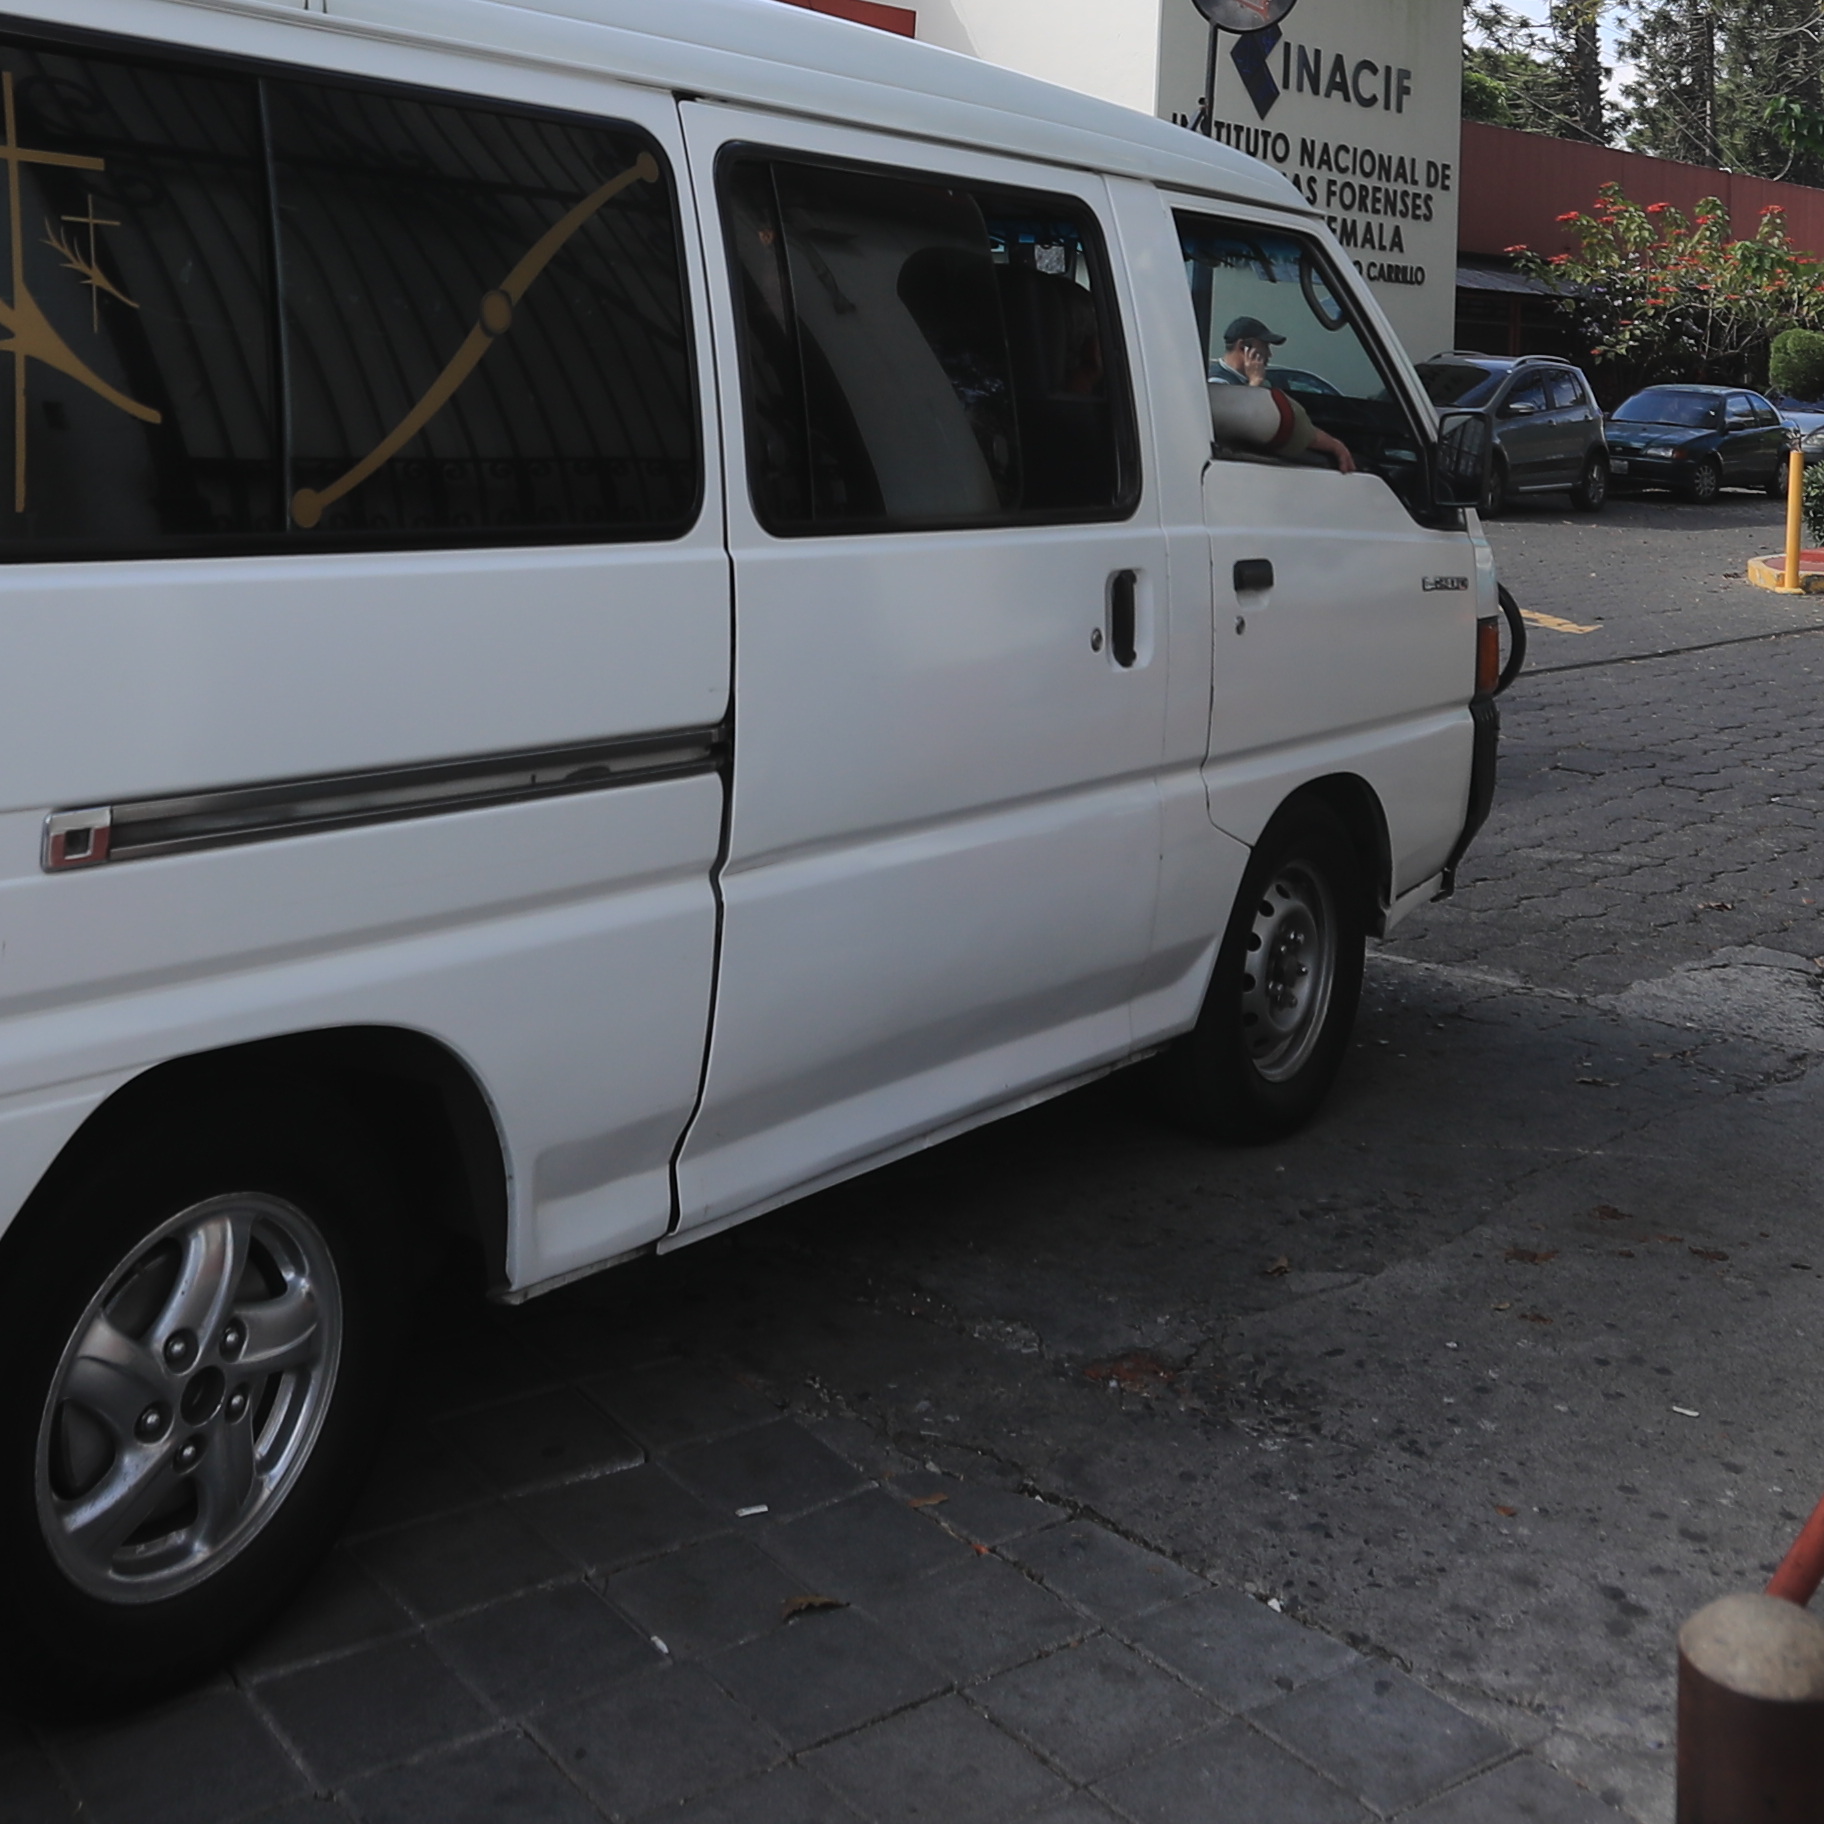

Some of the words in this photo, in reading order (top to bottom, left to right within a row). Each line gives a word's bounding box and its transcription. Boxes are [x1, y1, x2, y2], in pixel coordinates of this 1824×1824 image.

[1282, 41, 1412, 114] INACIF
[1300, 137, 1419, 186] NACIONAL
[1426, 160, 1451, 191] DE
[1326, 179, 1433, 222] FORENSES
[1367, 261, 1425, 285] CARRILLO
